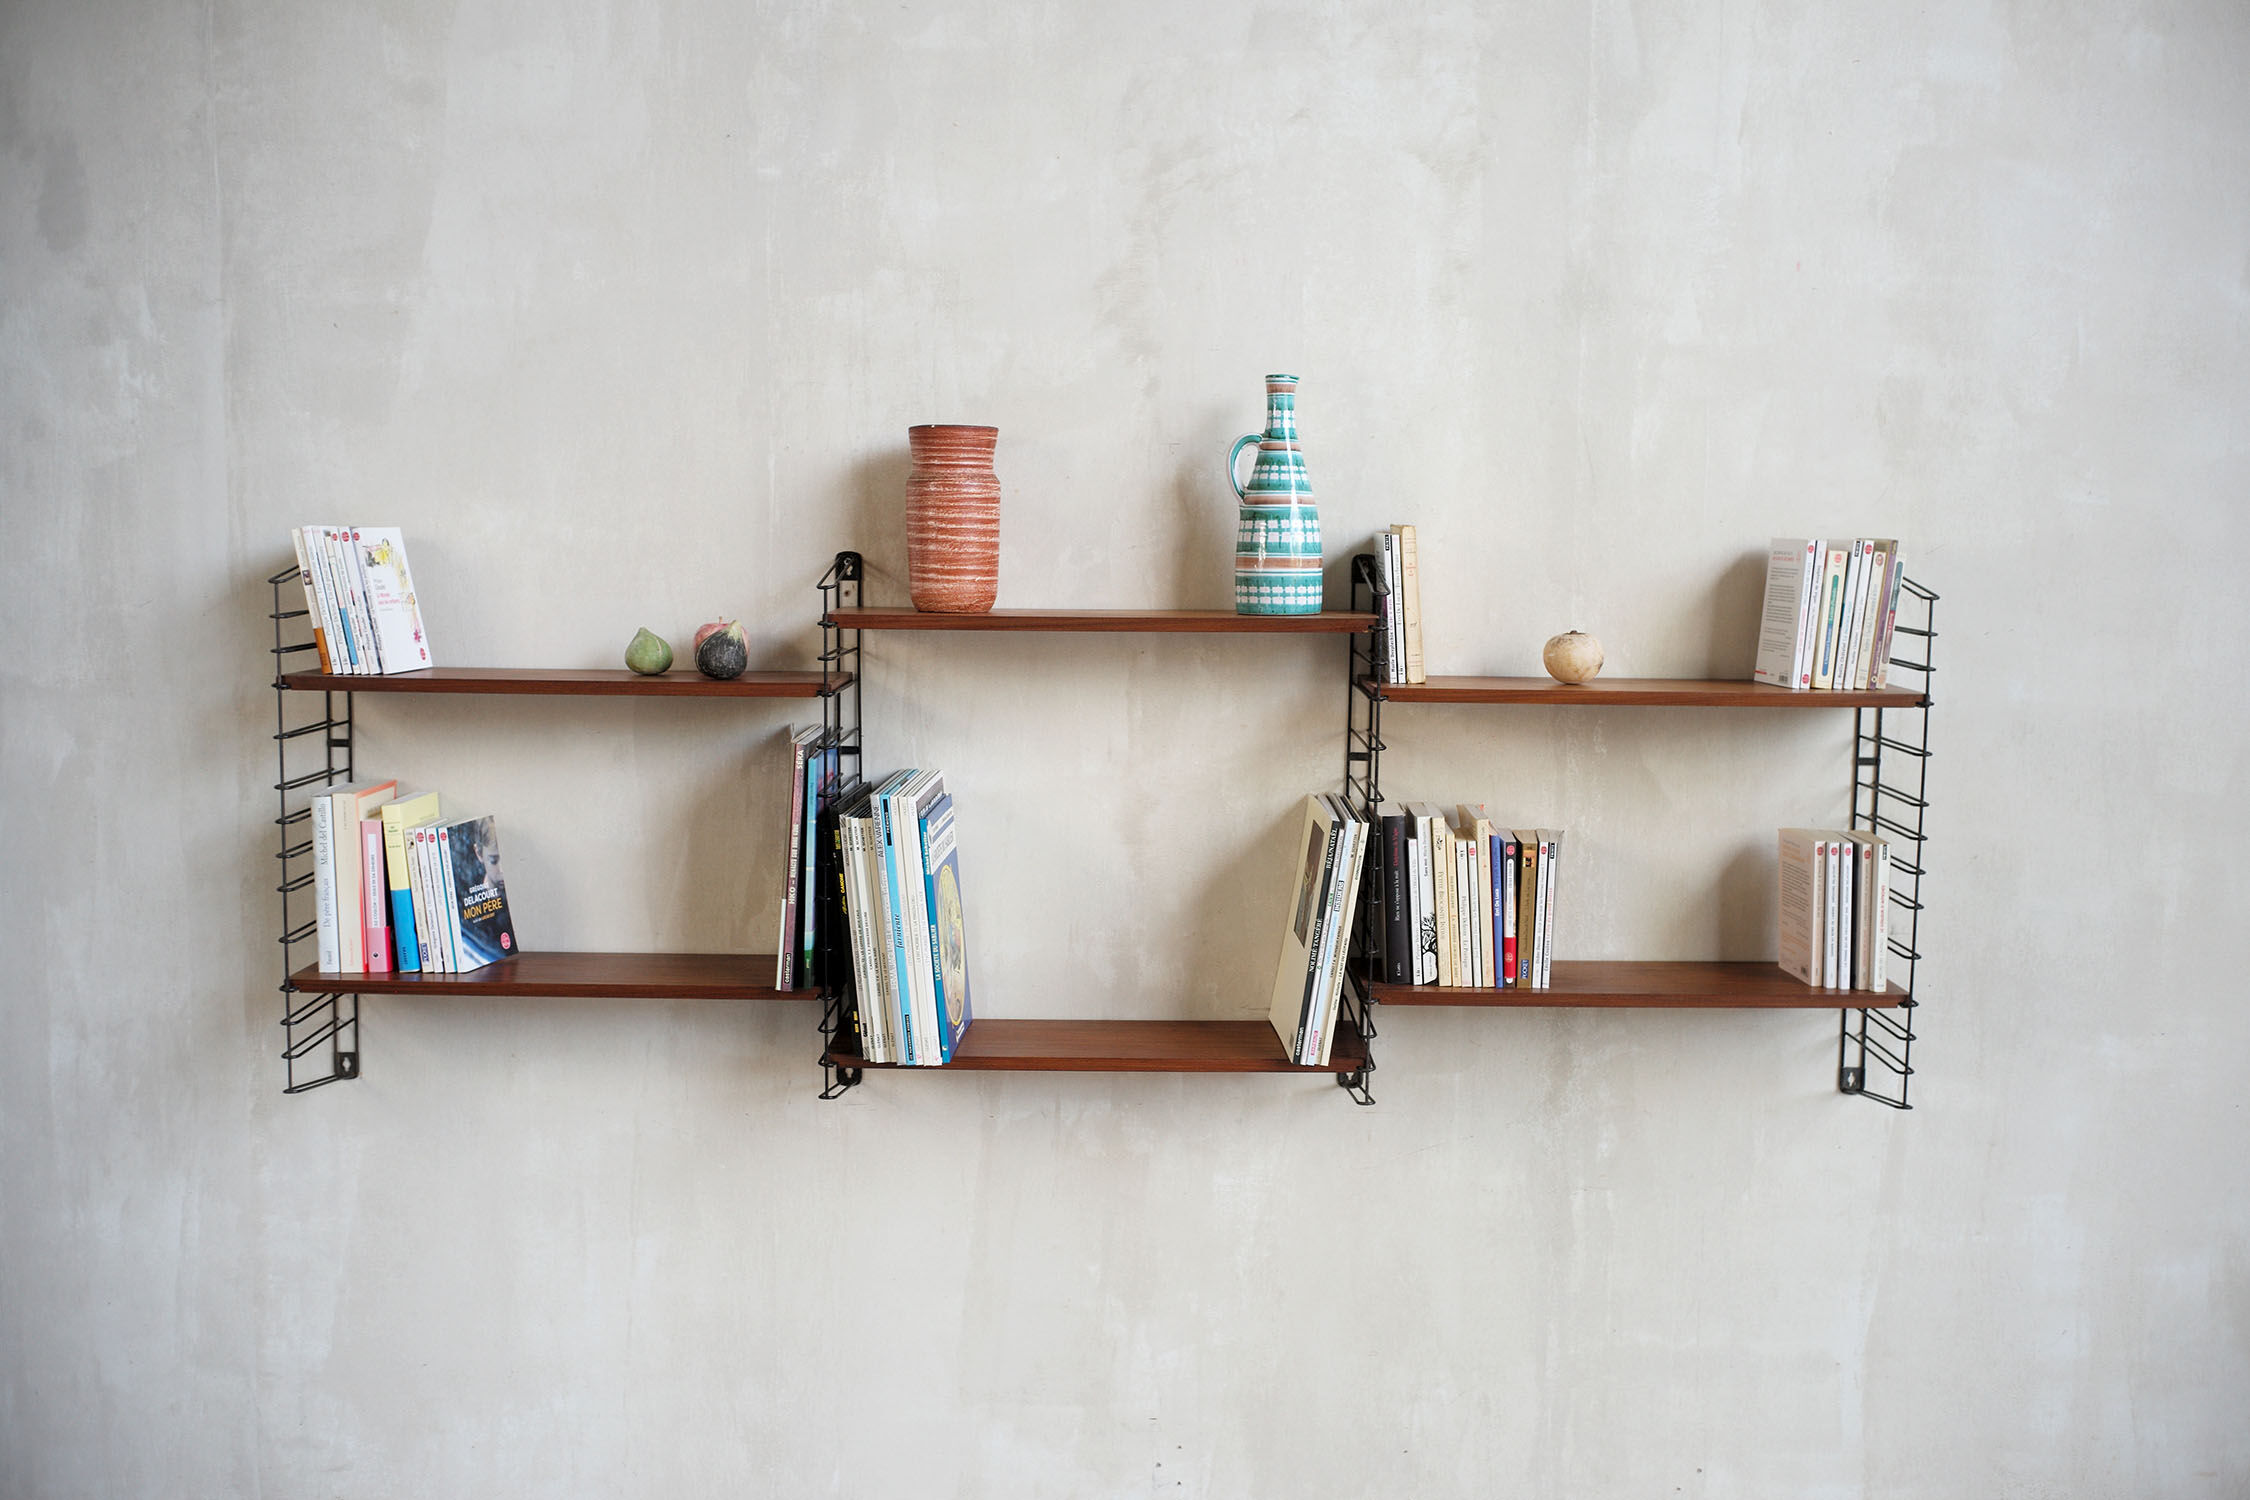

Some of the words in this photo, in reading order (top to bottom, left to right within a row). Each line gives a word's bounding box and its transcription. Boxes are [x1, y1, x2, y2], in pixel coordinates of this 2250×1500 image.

[318, 803, 327, 829] Castillo
[319, 831, 328, 841] del
[320, 842, 329, 865] Michel
[321, 878, 331, 901] français
[464, 888, 498, 906] DELACOURT
[464, 906, 482, 920] MON
[483, 898, 502, 913] PÈRE
[323, 918, 330, 928] De
[1295, 1026, 1304, 1056] casterman
